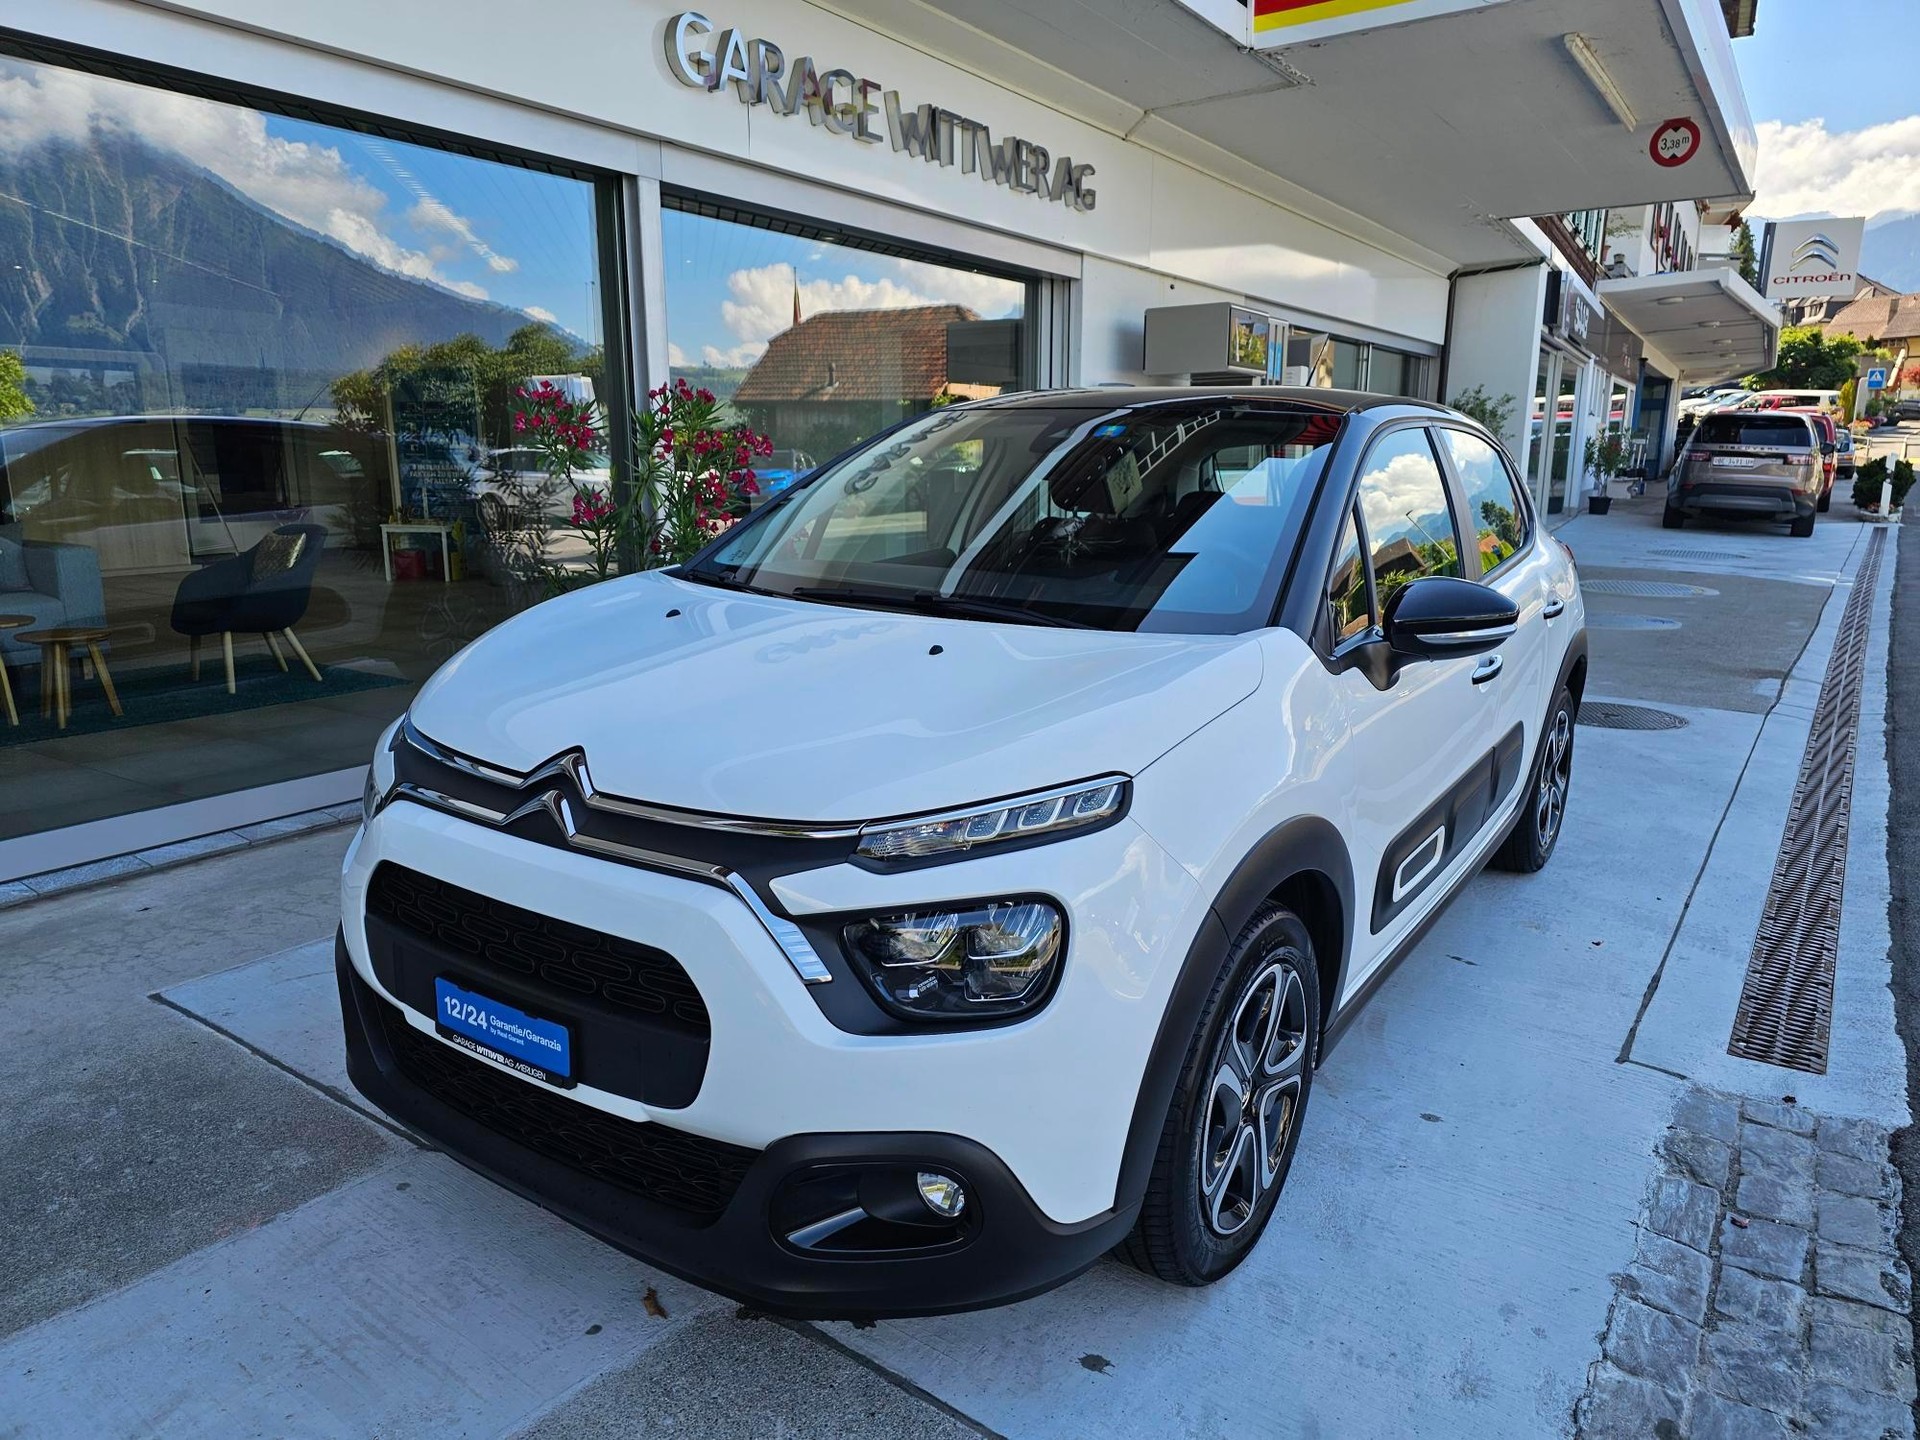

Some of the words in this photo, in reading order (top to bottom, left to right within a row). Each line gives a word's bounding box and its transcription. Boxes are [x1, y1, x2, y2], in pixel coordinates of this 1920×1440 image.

[664, 11, 883, 143] GARAGE
[884, 90, 1051, 198] WITTWER
[1049, 156, 1096, 212] AG
[1773, 271, 1851, 285] CITROËN
[444, 995, 488, 1030] 12/24
[489, 1015, 562, 1052] Garantie/Garanzia
[490, 1027, 497, 1035] by
[452, 1034, 477, 1052] GARAGE
[504, 1057, 515, 1068] AG
